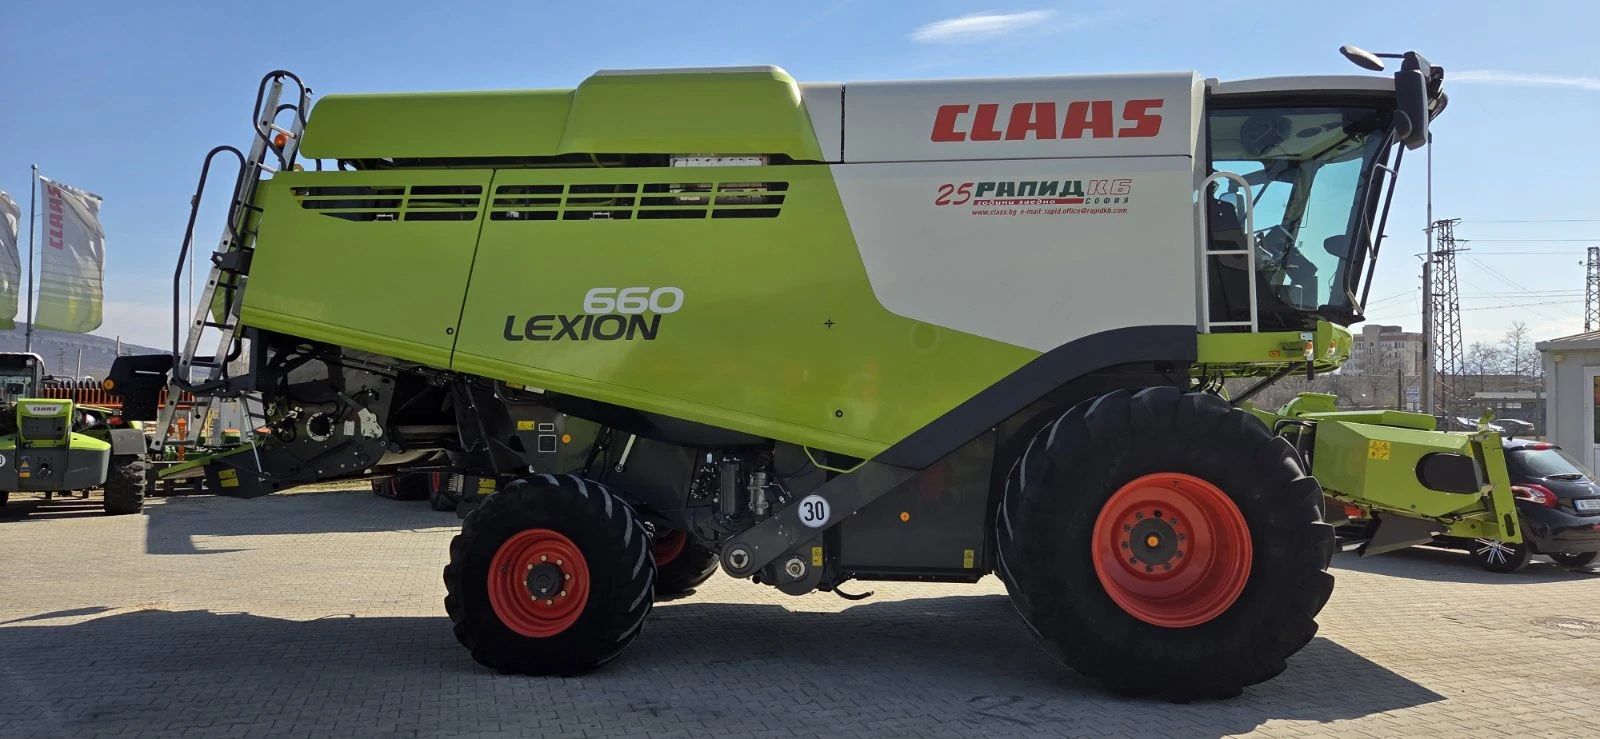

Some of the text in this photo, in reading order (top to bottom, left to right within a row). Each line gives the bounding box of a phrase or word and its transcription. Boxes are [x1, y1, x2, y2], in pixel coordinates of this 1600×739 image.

[931, 99, 1164, 143] CLAAS
[935, 179, 1132, 206] 25 РАПИД КБ
[583, 287, 684, 314] 660
[503, 314, 662, 341] LEXION
[804, 501, 824, 521] 30
